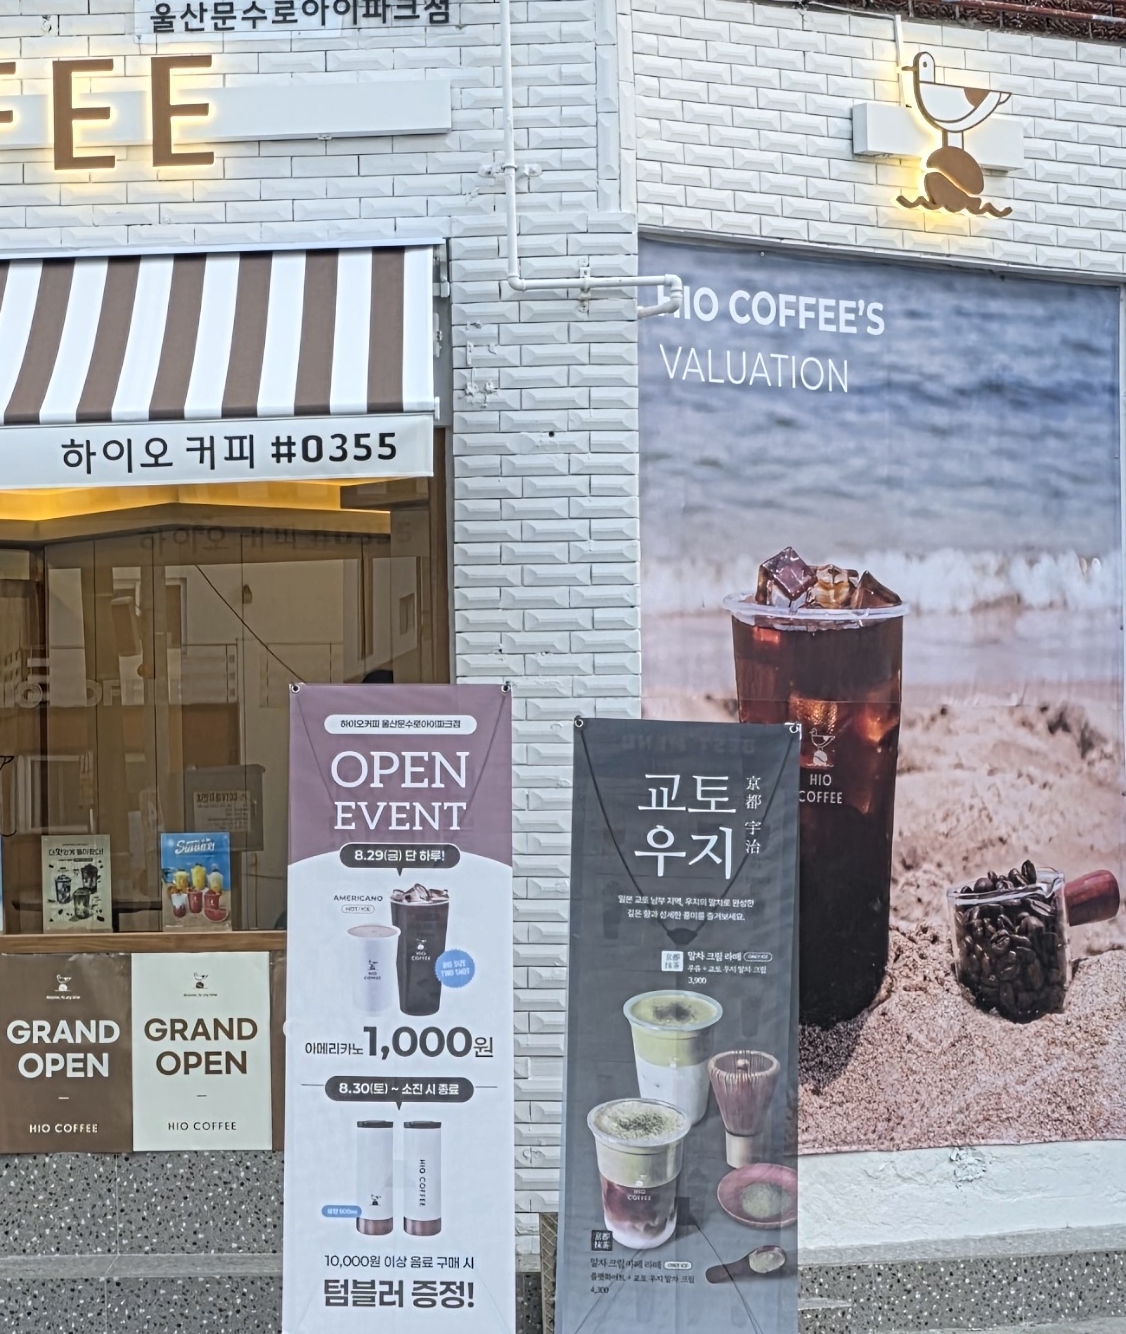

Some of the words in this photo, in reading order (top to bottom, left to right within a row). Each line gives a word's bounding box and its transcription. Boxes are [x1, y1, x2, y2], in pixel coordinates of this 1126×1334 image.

[729, 290, 885, 336] COFFEE'S
[659, 344, 848, 393] VALUATION
[61, 436, 173, 474] 하이오
[185, 434, 256, 470] 커피
[270, 432, 398, 464] #0355
[340, 719, 380, 729] 하이오커피
[331, 751, 470, 788] OPEN
[809, 773, 832, 786] HIO
[638, 774, 736, 813] 교토
[334, 801, 467, 830] EVENT
[354, 849, 402, 863] 8.29(금)
[405, 849, 418, 862] 단
[419, 849, 445, 862] 하루!
[634, 825, 732, 879] 우지
[333, 894, 383, 902] AMERICANO
[7, 1020, 120, 1045] GRAND
[144, 1018, 258, 1042] GRAND
[305, 1042, 363, 1055] 아메리카노
[363, 1026, 494, 1060] 1,000원
[18, 1052, 109, 1078] OPEN
[156, 1051, 247, 1075] OPEN
[339, 1082, 388, 1095] 8.30(토)
[401, 1083, 423, 1095] 소진
[425, 1084, 436, 1095] 시
[438, 1084, 460, 1095] 종료
[29, 1124, 51, 1133] HIO
[54, 1124, 98, 1133] COFFEE
[168, 1122, 189, 1131] HIO
[193, 1122, 237, 1131] COFFEE
[324, 1255, 381, 1268] 10,000원
[384, 1255, 407, 1268] 이상
[410, 1256, 434, 1269] 음료
[436, 1257, 460, 1269] 구매
[463, 1257, 474, 1269] 시
[324, 1279, 404, 1308] 텀블러
[411, 1280, 475, 1309] 증정!
